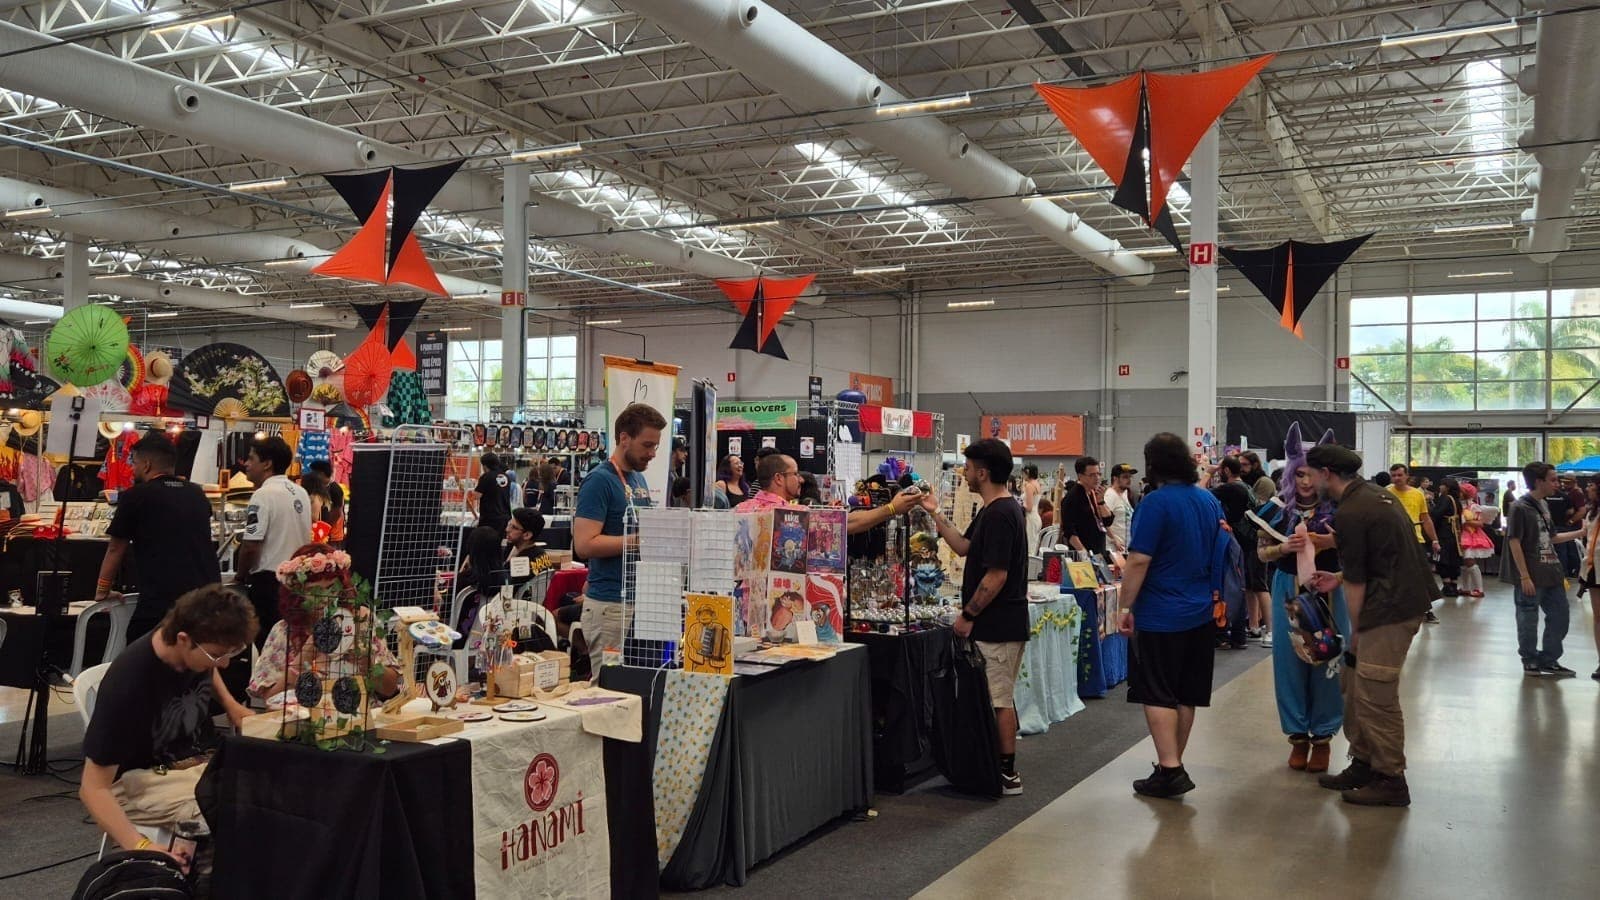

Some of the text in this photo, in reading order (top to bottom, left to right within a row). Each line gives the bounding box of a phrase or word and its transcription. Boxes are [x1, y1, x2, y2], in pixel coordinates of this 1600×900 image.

[1194, 246, 1208, 262] H
[505, 293, 513, 304] E
[1120, 366, 1129, 375] H
[750, 404, 787, 412] LOVERS
[1006, 423, 1057, 441] JUST DANCE
